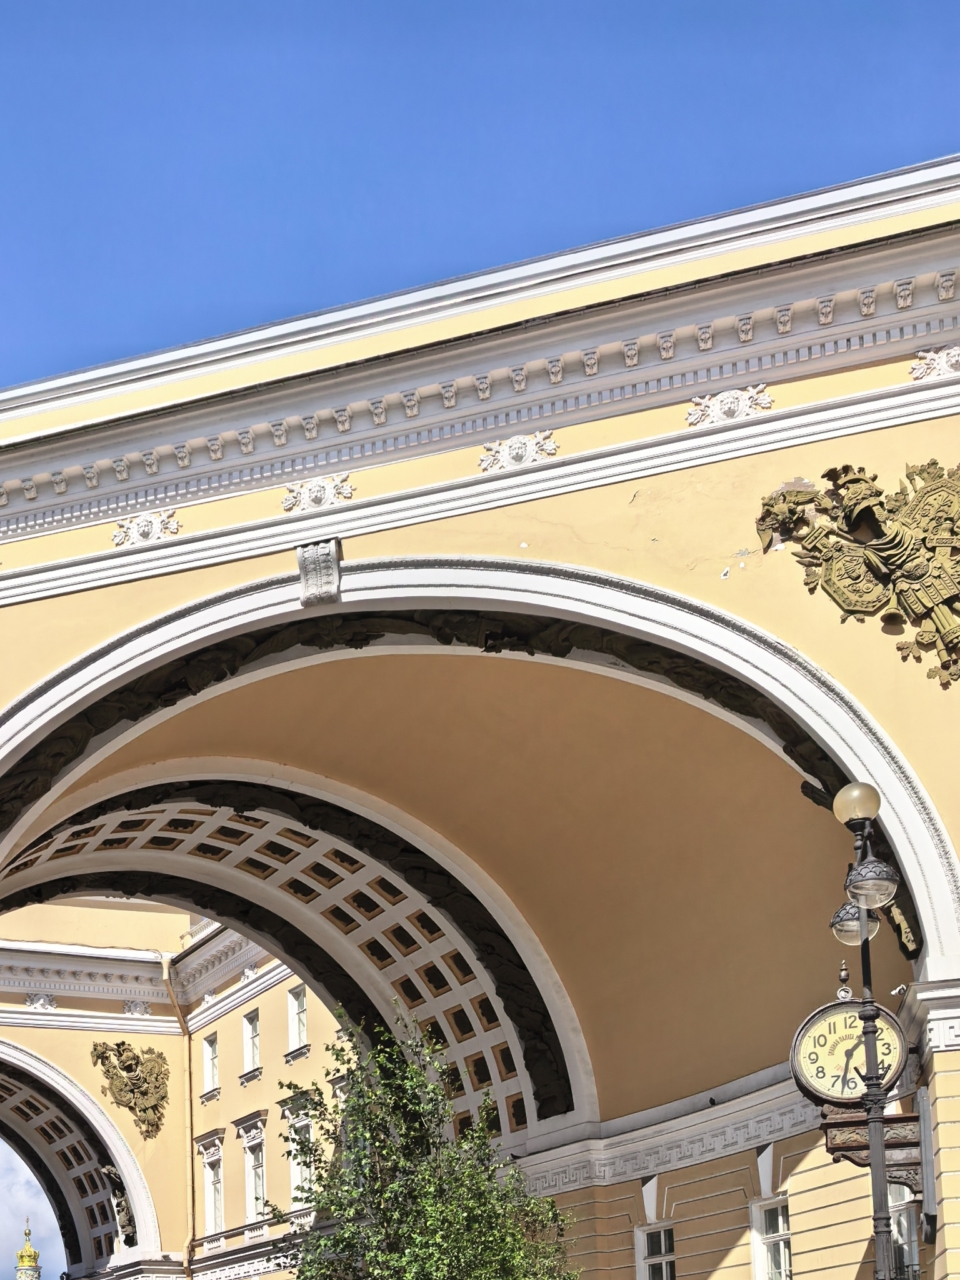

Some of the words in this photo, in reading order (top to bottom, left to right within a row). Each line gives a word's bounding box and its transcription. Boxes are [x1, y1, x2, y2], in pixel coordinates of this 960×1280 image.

[828, 1021, 836, 1034] 11
[844, 1015, 858, 1029] 12
[876, 1027, 885, 1041] 2
[813, 1034, 827, 1048] 10
[881, 1042, 892, 1056] 3
[808, 1051, 819, 1064] 9
[877, 1059, 887, 1072] 4
[815, 1066, 826, 1079] 8
[831, 1075, 841, 1088] 7
[846, 1077, 858, 1090] 6
